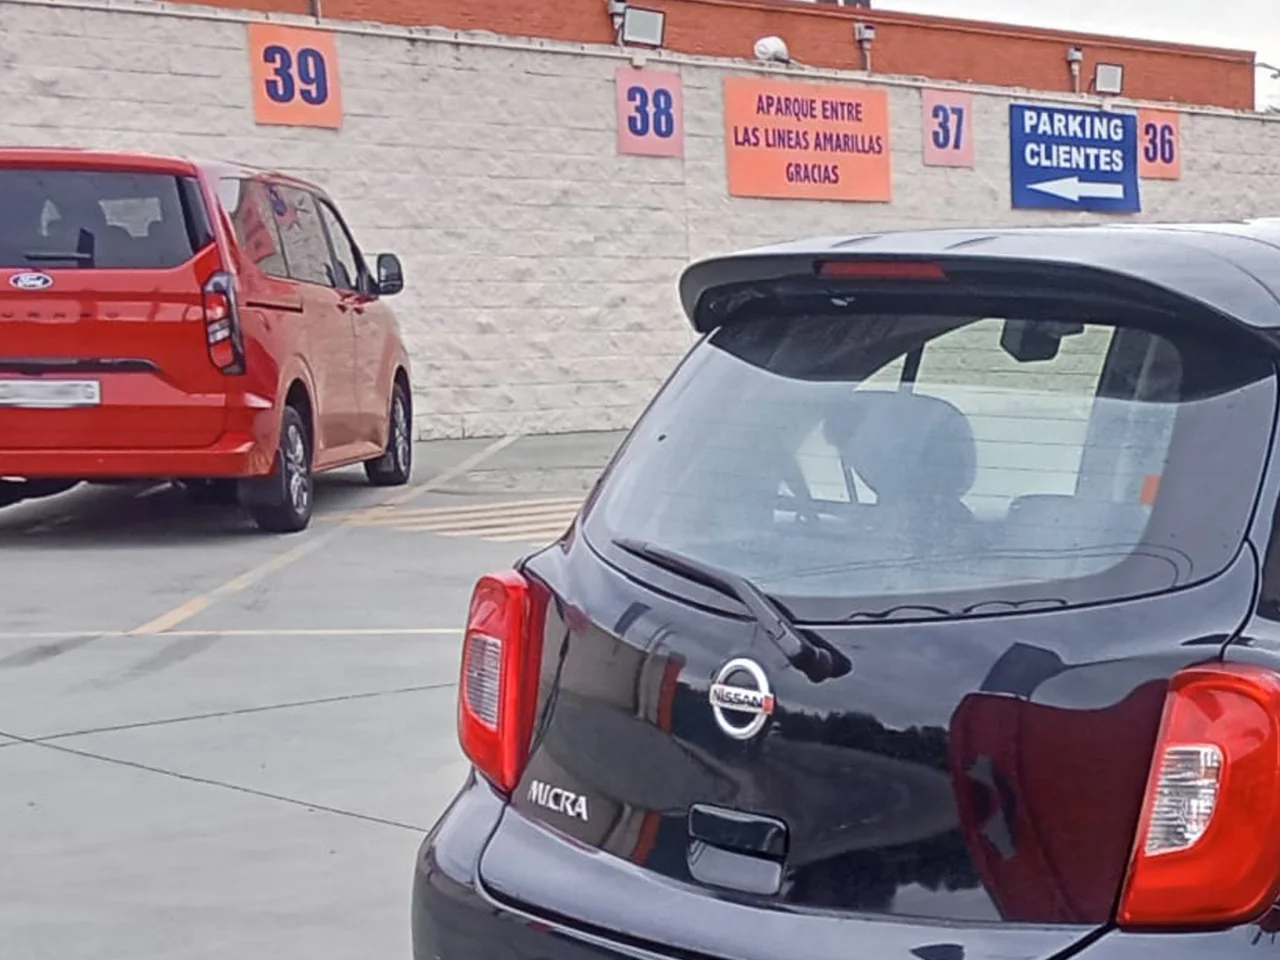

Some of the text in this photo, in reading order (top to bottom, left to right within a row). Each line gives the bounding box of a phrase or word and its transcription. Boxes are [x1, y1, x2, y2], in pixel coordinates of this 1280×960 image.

[263, 45, 328, 105] 39
[627, 86, 675, 138] 38
[756, 94, 862, 121] APARQUE ENTRE
[734, 126, 882, 155] LAS LINEAS AMARILLAS
[932, 104, 965, 150] 37
[1024, 111, 1123, 141] PARKING
[1025, 143, 1124, 172] CLIENTES
[1144, 123, 1175, 164] 36
[786, 160, 840, 184] GRACIAS
[712, 687, 763, 708] NISSAN
[528, 780, 589, 821] MICRA
